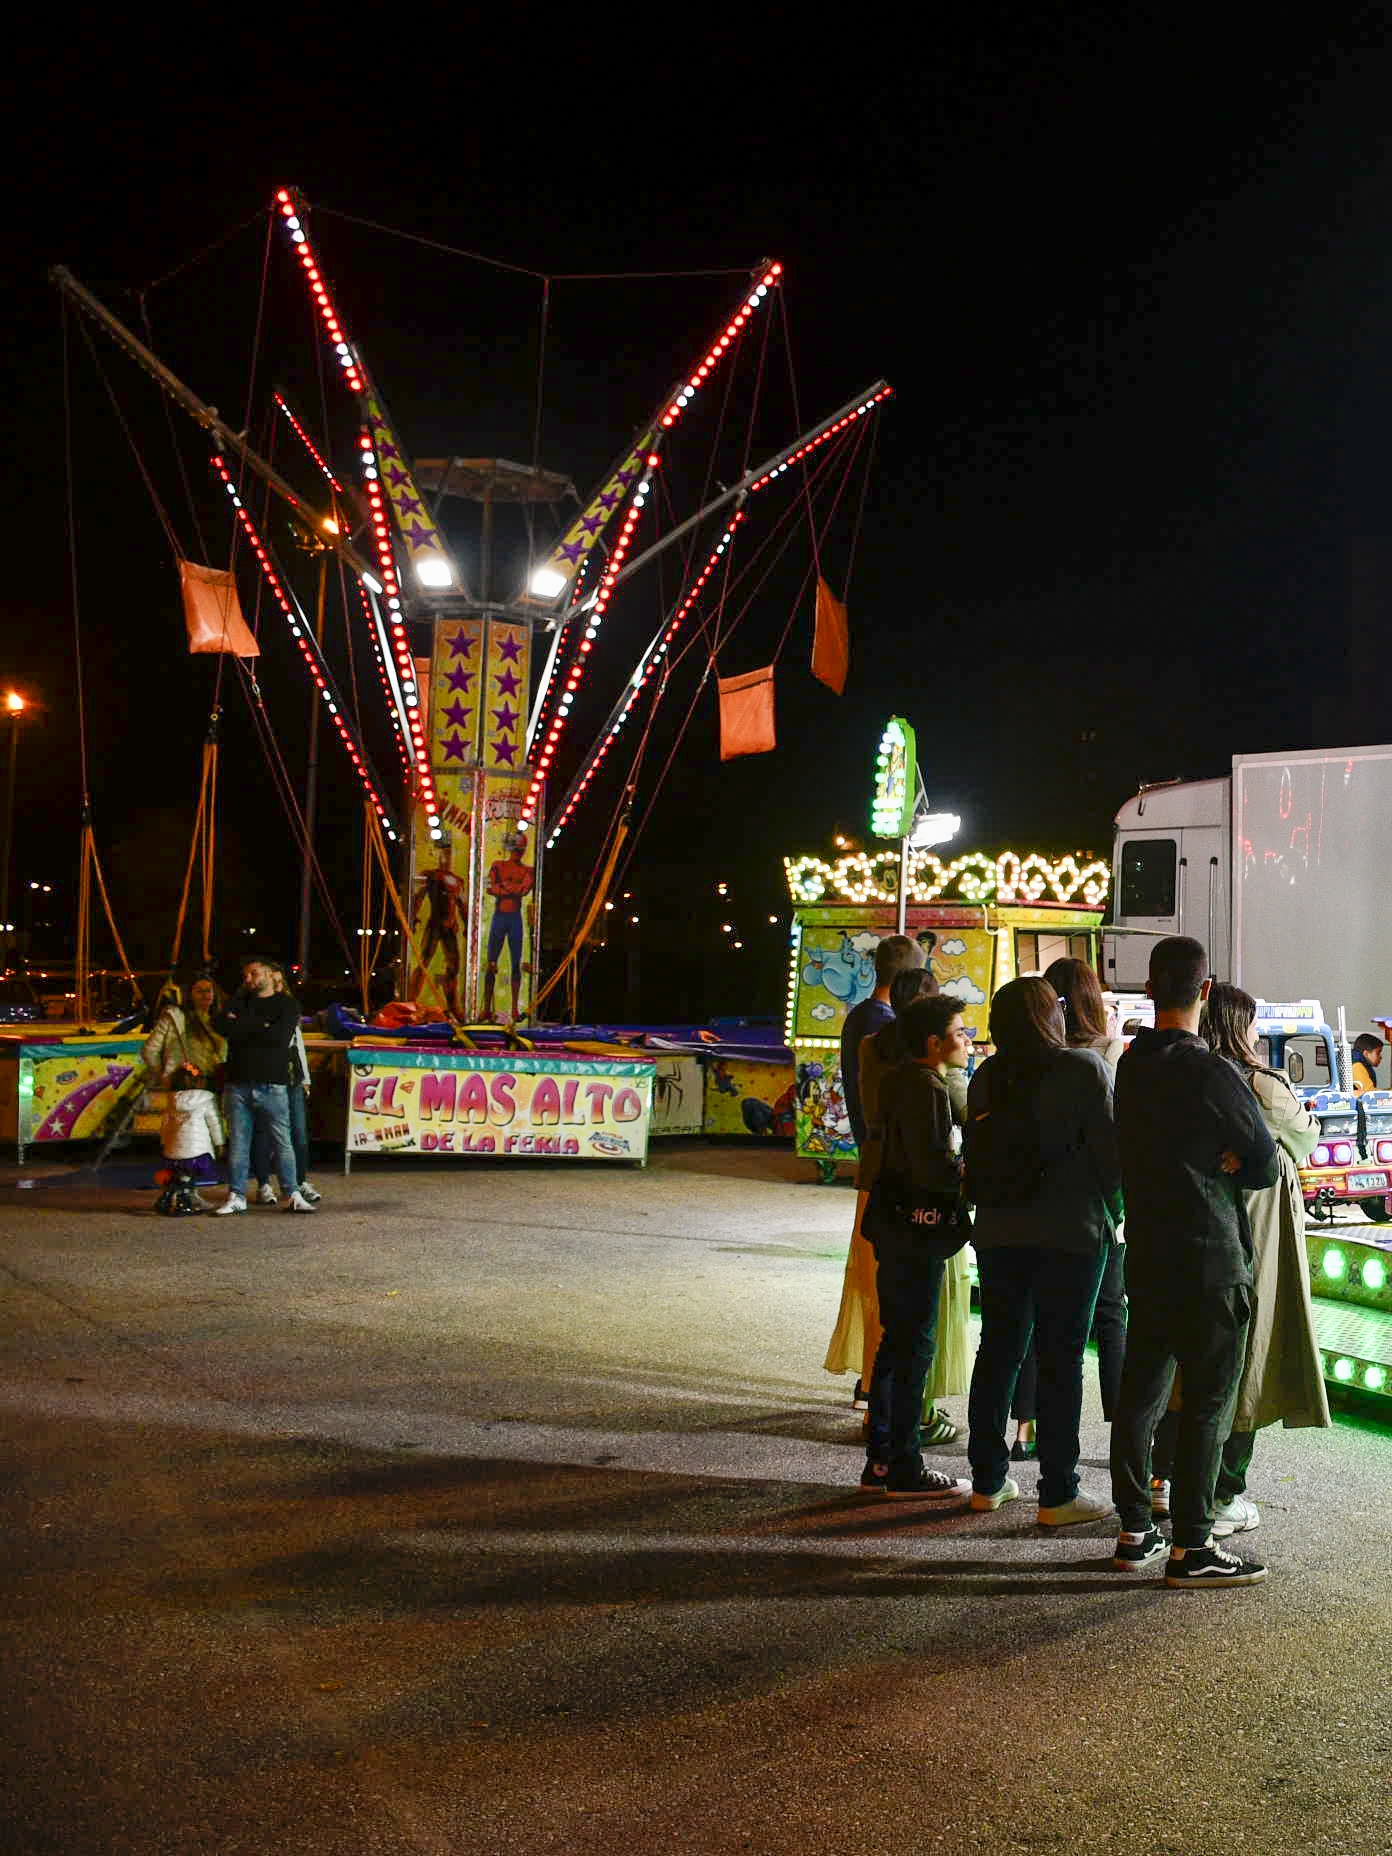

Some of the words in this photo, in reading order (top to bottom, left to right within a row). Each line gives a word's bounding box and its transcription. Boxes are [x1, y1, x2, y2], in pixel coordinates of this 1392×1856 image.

[352, 1076, 405, 1119] EL
[419, 1072, 517, 1127] MAS
[531, 1077, 642, 1127] ALTO
[420, 1129, 455, 1152] DE
[462, 1131, 496, 1153] LA
[504, 1132, 581, 1155] FERIA
